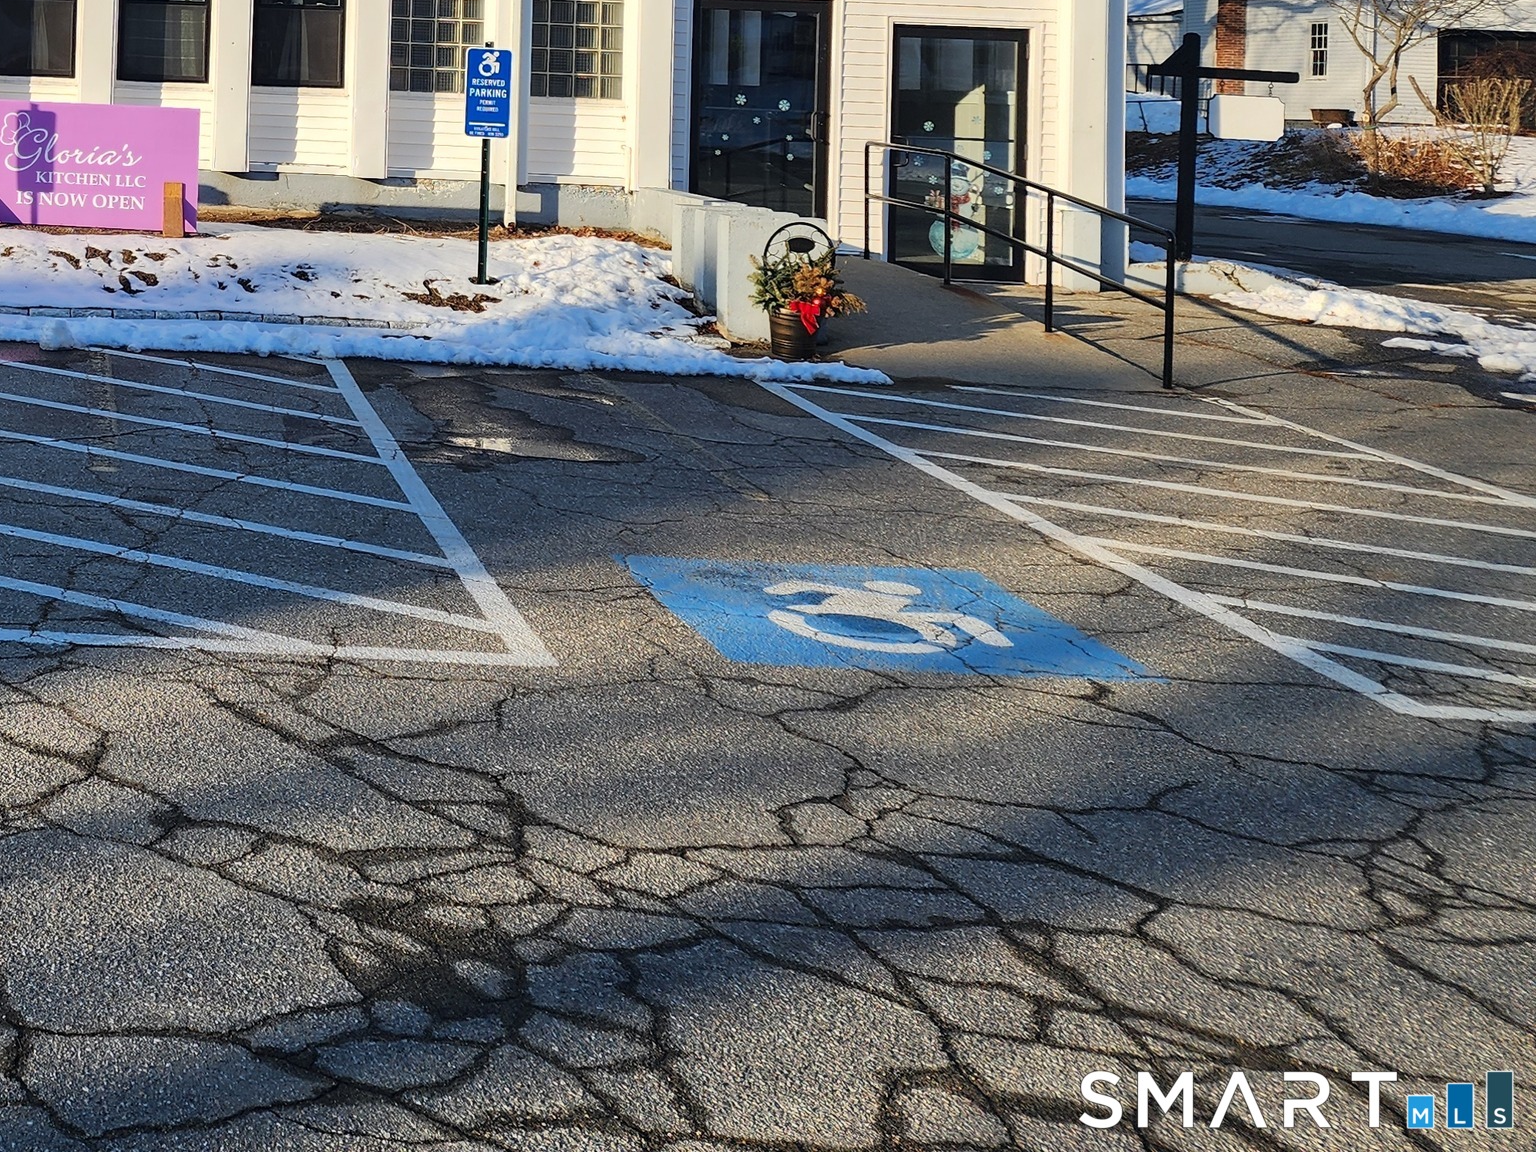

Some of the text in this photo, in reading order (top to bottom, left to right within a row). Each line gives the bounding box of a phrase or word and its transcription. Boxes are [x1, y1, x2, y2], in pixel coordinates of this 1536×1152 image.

[471, 78, 506, 87] RESERVED
[469, 87, 507, 98] PARKING
[4, 128, 143, 171] Gloria's
[35, 170, 147, 188] KITCHEN LLC
[16, 190, 146, 211] IS NOW OPEN
